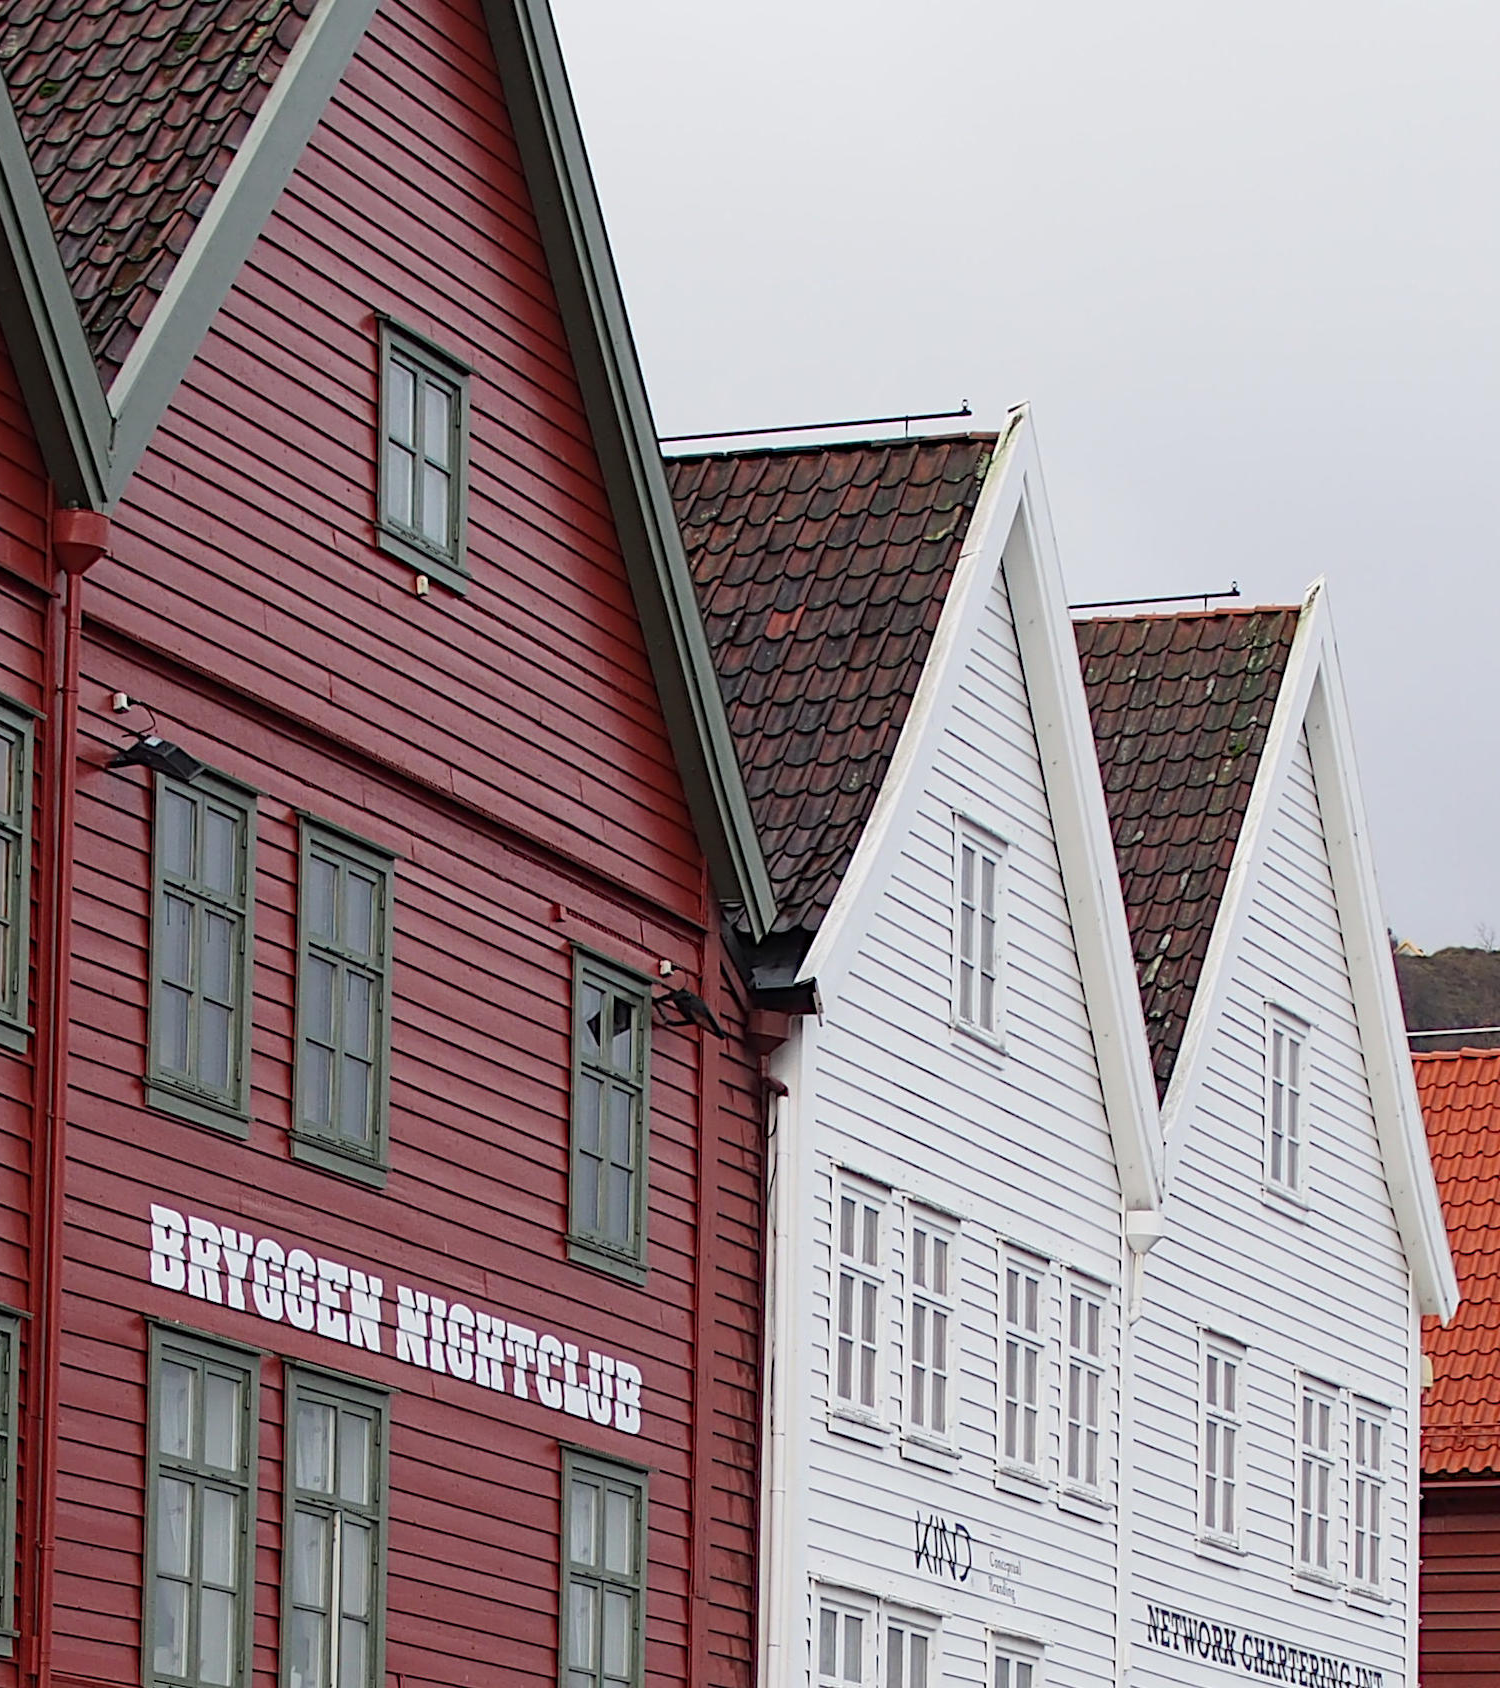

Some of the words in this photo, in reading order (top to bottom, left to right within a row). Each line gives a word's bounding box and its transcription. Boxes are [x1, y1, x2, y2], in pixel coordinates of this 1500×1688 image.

[150, 1203, 384, 1354] BRYGGEN
[396, 1284, 643, 1435] NIGHTCLUB
[914, 1510, 972, 1582] KIND
[1147, 1604, 1237, 1667] NETWORK
